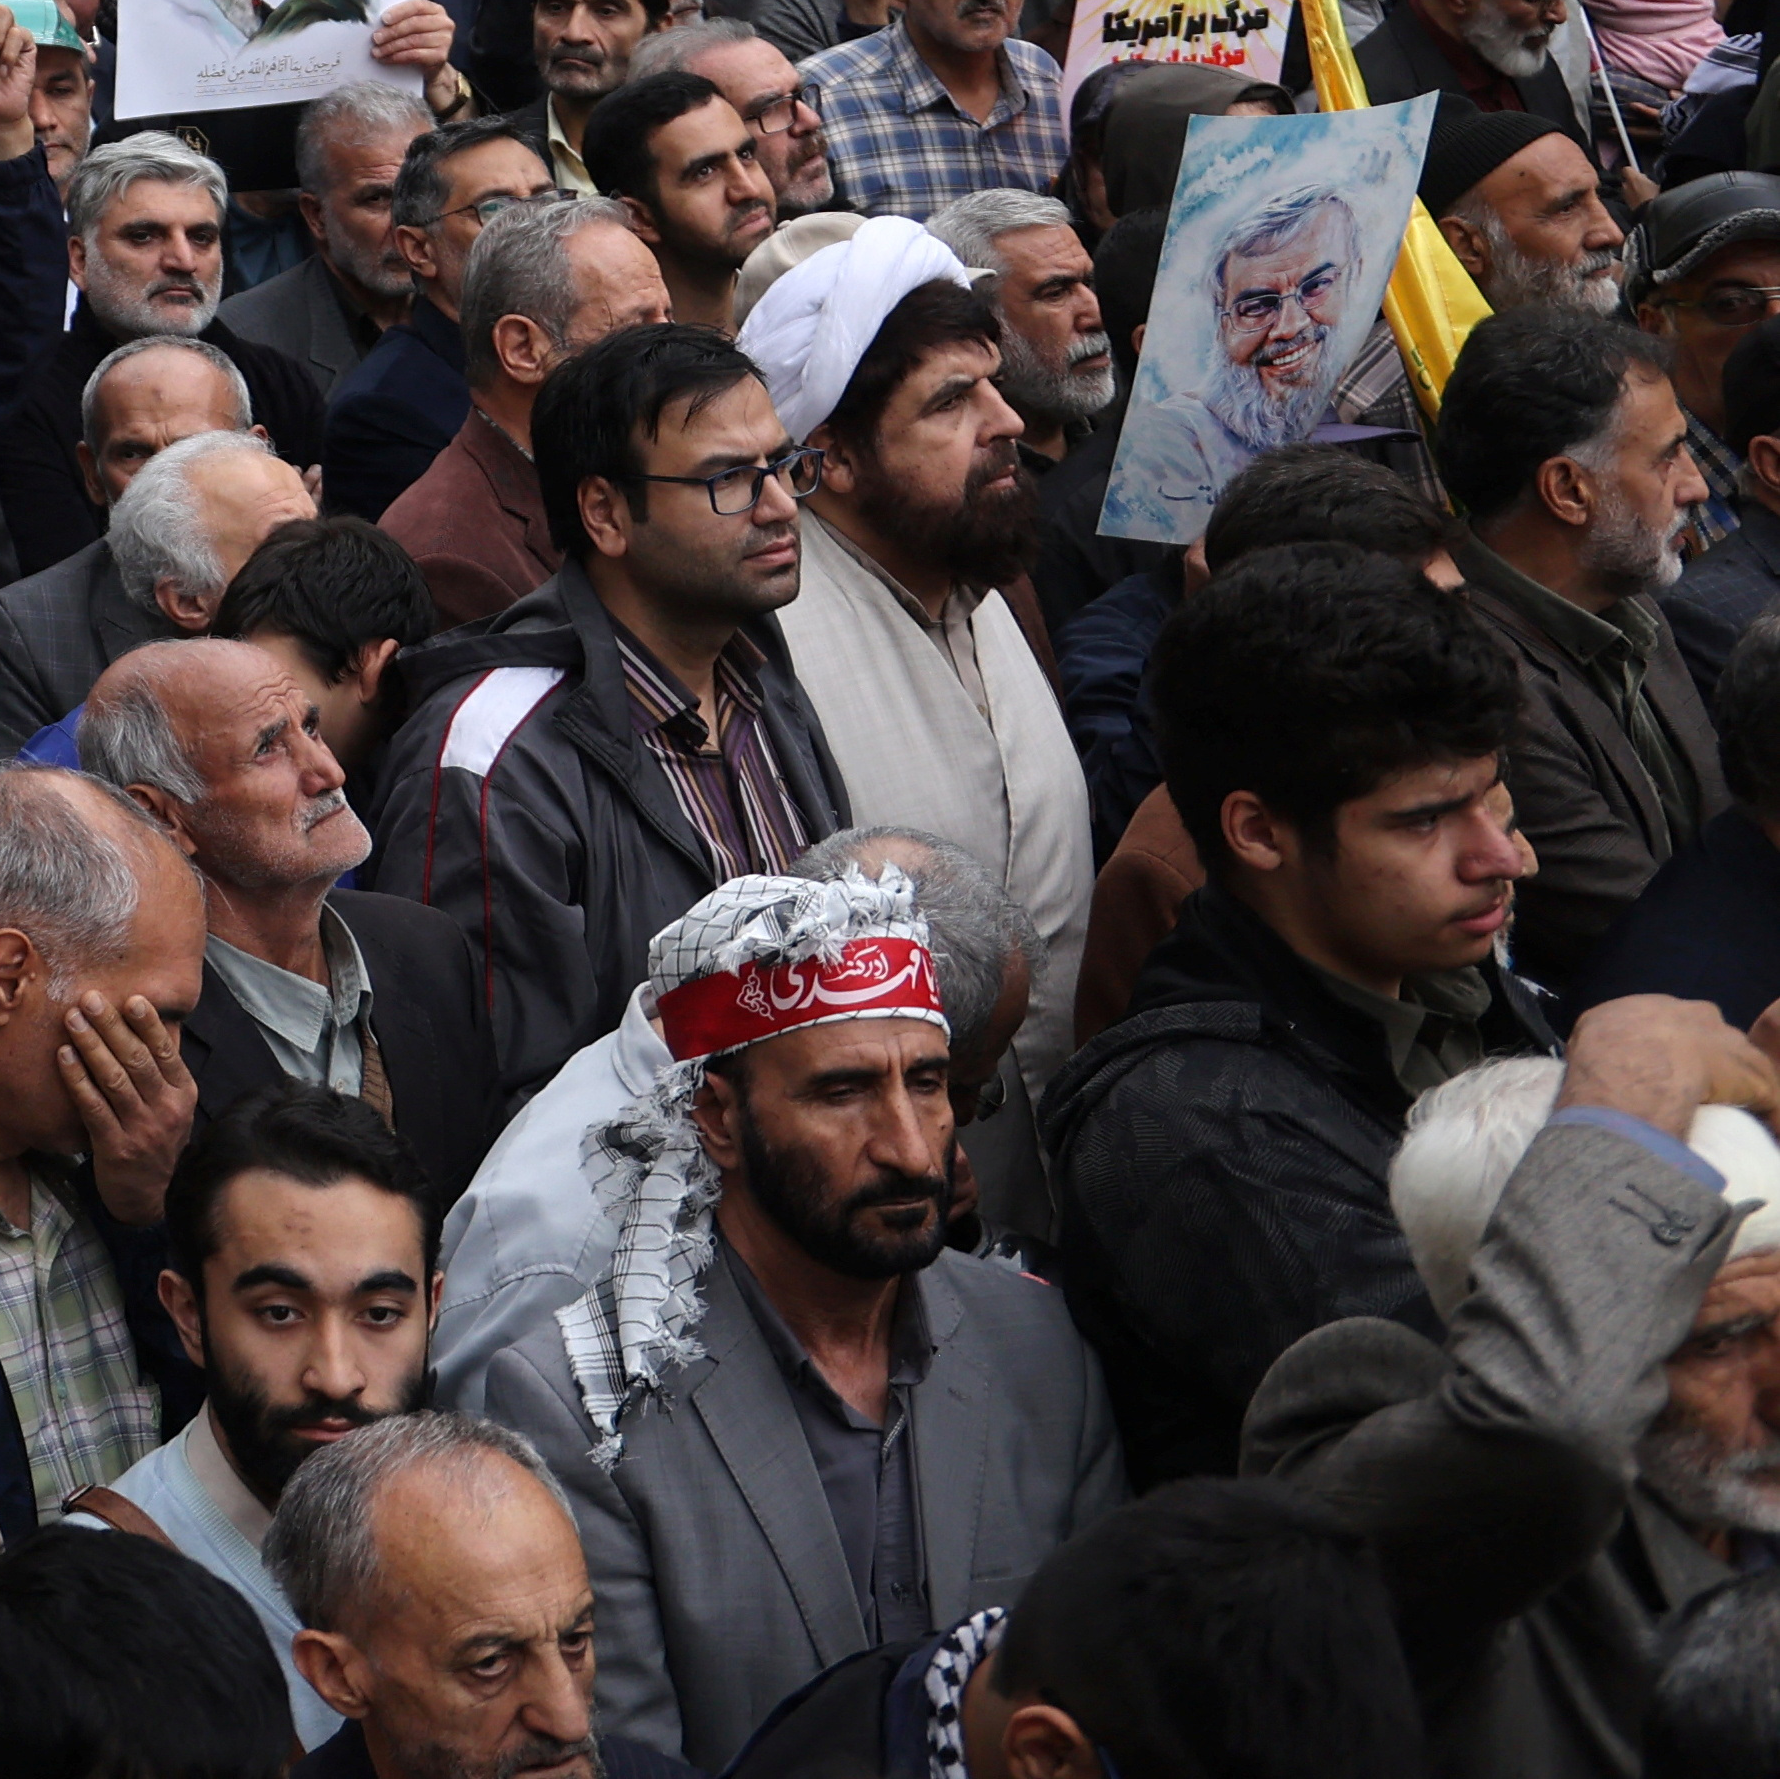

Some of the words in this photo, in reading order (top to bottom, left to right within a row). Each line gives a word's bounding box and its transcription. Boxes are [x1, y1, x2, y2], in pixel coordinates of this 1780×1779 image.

[1102, 2, 1184, 47] آمریکا
[1184, 12, 1206, 42] بر
[770, 949, 921, 1010] مهدی
[922, 953, 939, 1005] یا
